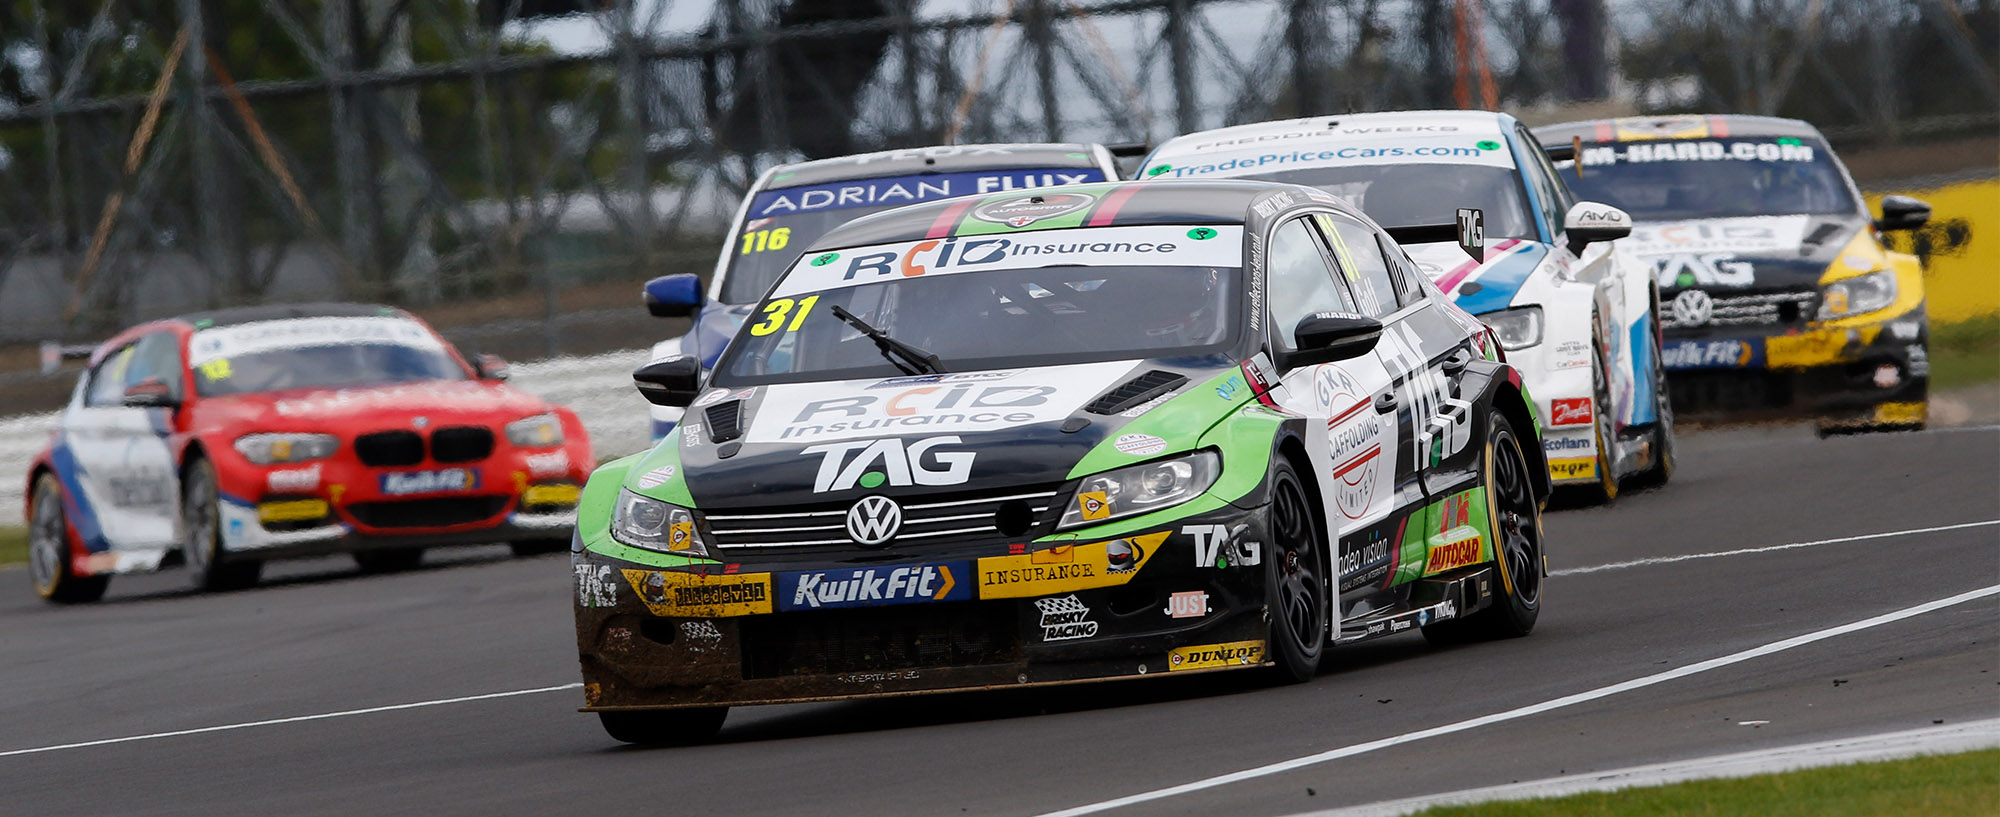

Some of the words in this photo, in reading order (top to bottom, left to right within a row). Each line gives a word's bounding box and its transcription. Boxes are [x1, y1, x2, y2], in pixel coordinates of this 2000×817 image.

[1342, 124, 1460, 136] WEEKS
[1170, 142, 1481, 180] TradePriceCars.com
[1553, 141, 1814, 168] M-HARD.COM
[762, 178, 950, 215] ADRIAN
[976, 172, 1088, 193] FLUX
[742, 226, 791, 256] 116
[1458, 209, 1483, 247] TAG
[1011, 240, 1177, 257] Insurance
[749, 295, 820, 338] 31
[1662, 339, 1741, 367] wikFit
[1316, 368, 1357, 407] GKR
[1328, 416, 1379, 461] CAFFOLDING
[800, 435, 977, 494] TAG
[1338, 467, 1374, 509] LIMITED
[1180, 523, 1261, 568] TAG
[1427, 537, 1479, 573] AUTOCAR
[575, 563, 617, 608] TAG
[792, 565, 937, 608] KwikFit
[984, 563, 1096, 586] INSURANCE
[1042, 610, 1086, 627] BRISKY
[1047, 623, 1097, 639] RACING
[1187, 646, 1262, 664] DUNLOP
